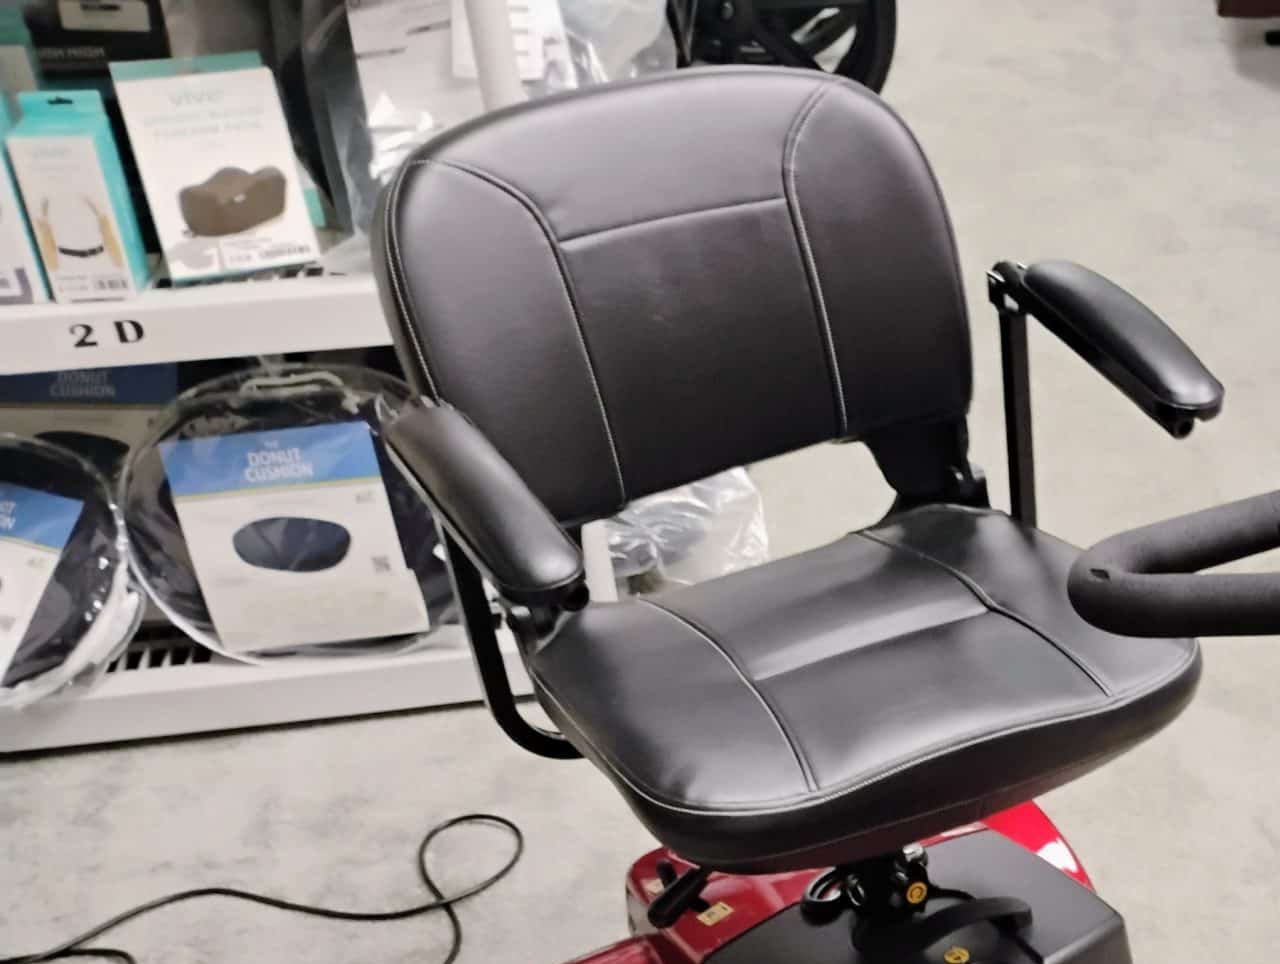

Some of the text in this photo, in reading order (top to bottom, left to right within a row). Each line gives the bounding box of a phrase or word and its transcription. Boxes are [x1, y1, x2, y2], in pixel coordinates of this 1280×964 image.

[69, 319, 145, 348] 2 D
[246, 447, 302, 466] DONUT
[244, 462, 314, 483] CUSHION
